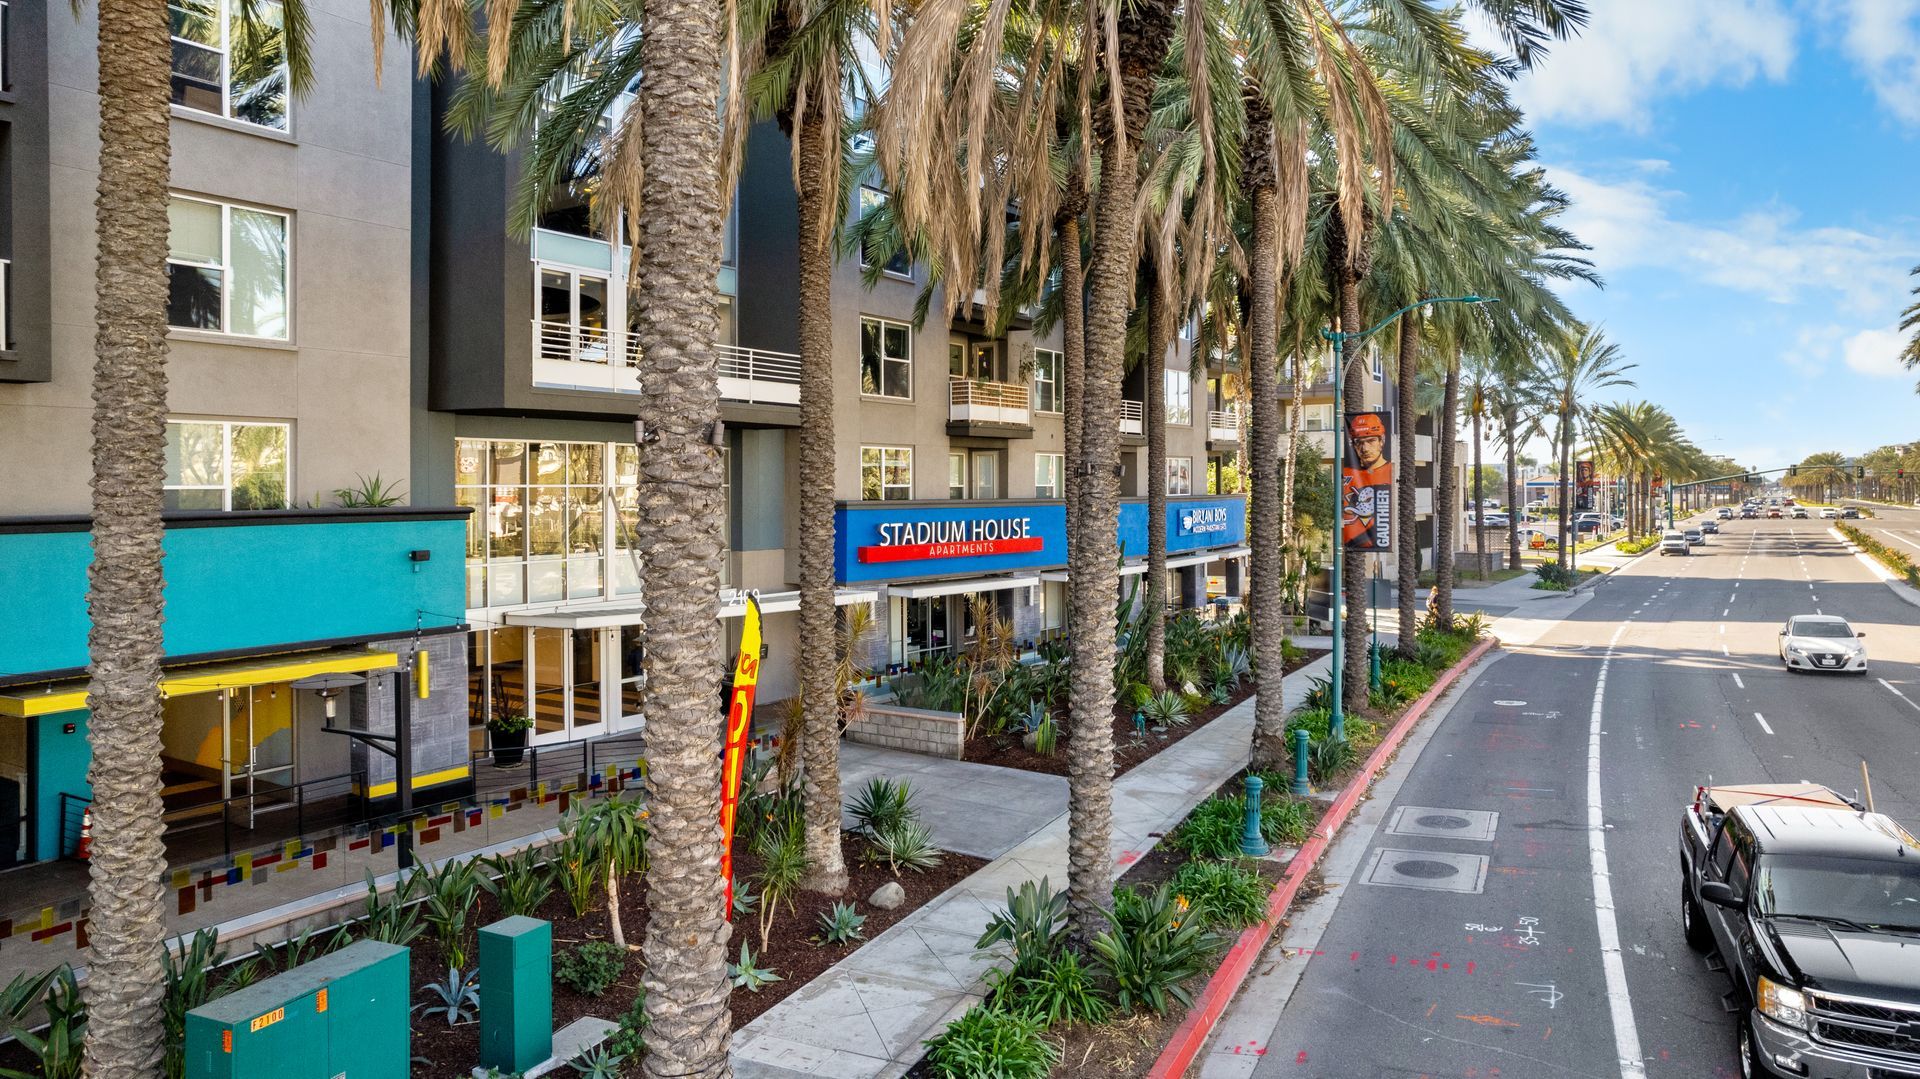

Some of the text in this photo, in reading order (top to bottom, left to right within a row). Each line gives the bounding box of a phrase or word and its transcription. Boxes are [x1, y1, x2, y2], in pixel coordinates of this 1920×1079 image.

[1214, 507, 1227, 522] BOYS
[1376, 490, 1390, 548] GAUTHIER
[879, 517, 1031, 547] STADIUM HOUSE
[929, 542, 994, 556] APARTMENTS
[252, 1009, 283, 1030] F2100
